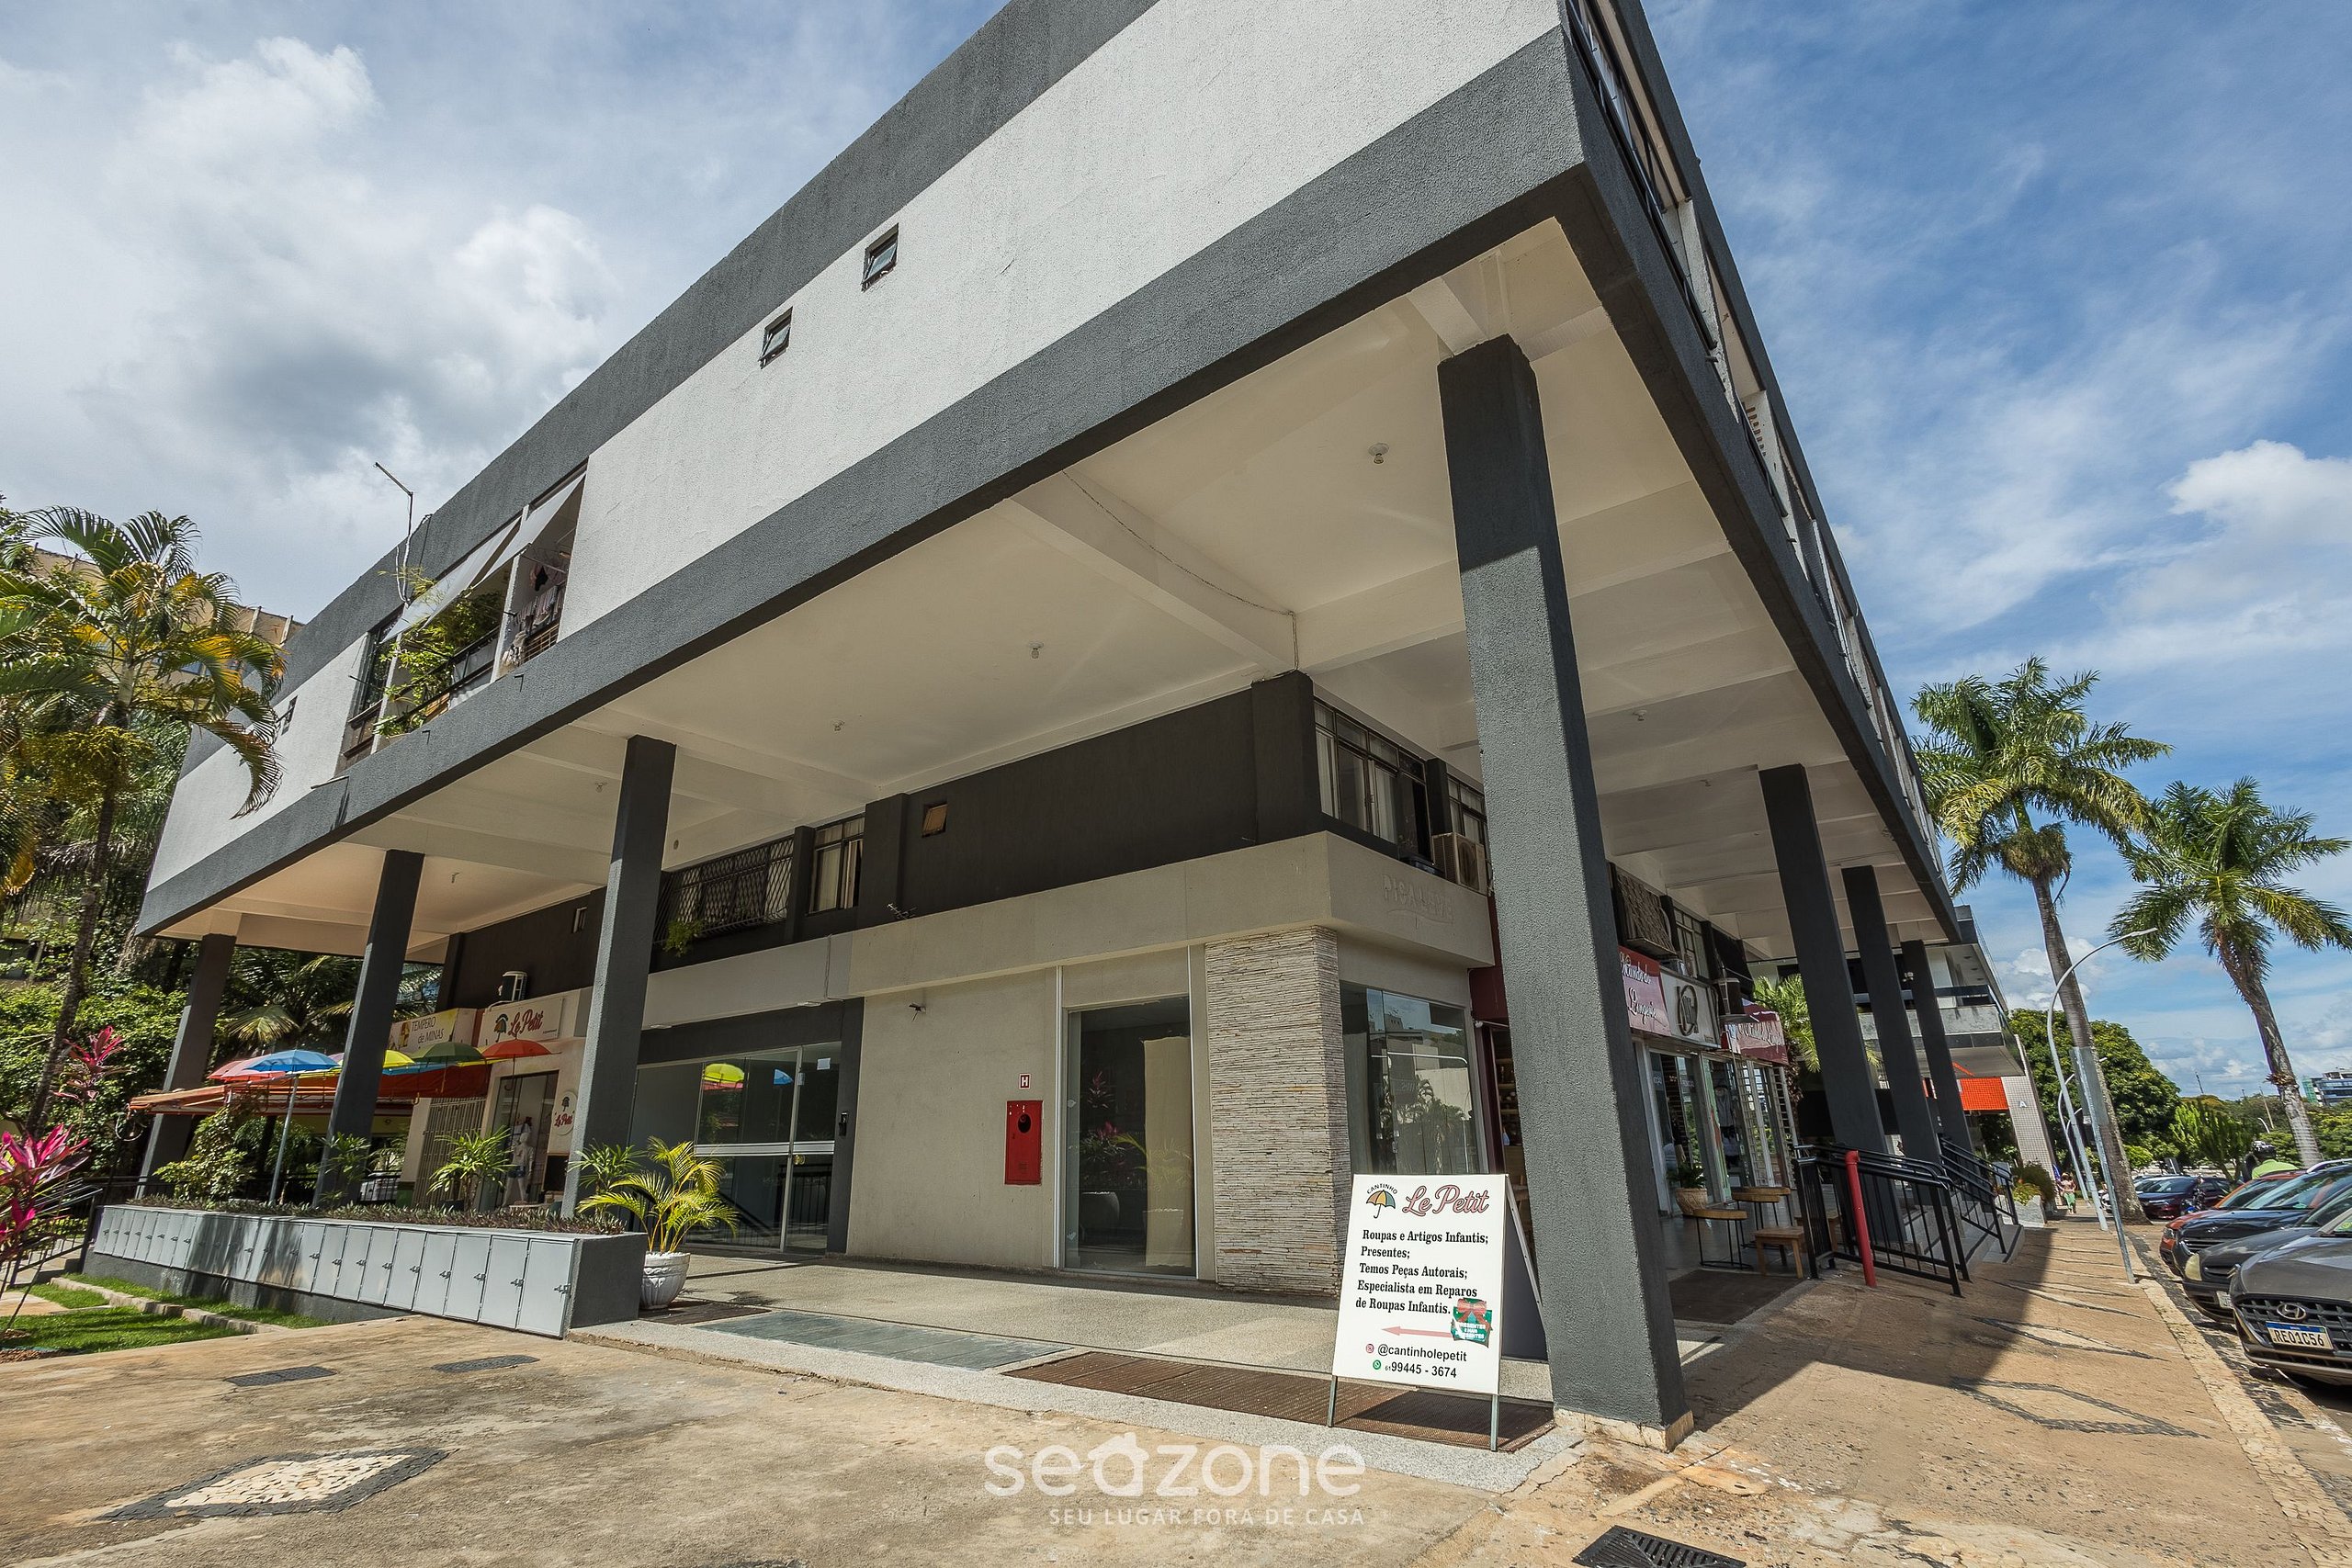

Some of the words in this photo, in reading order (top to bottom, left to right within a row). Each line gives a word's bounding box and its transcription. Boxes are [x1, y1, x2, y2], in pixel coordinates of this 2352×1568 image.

[412, 1016, 436, 1032] TEMPERO
[507, 1011, 521, 1037] Le
[519, 1009, 544, 1034] Petit
[417, 1033, 425, 1043] de
[424, 1028, 445, 1042] MINAS
[1021, 1077, 1029, 1087] H
[1366, 1183, 1398, 1195] CANTINHO
[1401, 1185, 1433, 1217] Le
[1431, 1184, 1490, 1214] Petit
[1363, 1229, 1397, 1243] Roupas
[1399, 1233, 1406, 1241] e
[1407, 1231, 1443, 1245] Artigos
[1445, 1231, 1489, 1245] Infantis;
[1361, 1246, 1410, 1259] Presentes;
[1359, 1262, 1389, 1275] Temos
[1391, 1264, 1419, 1279] Peças
[1421, 1266, 1468, 1280] Autorais;
[1357, 1280, 1416, 1294] Especialista
[1418, 1285, 1433, 1295] em
[1435, 1284, 1477, 1298] Reparos
[1355, 1297, 1367, 1309] de
[1369, 1297, 1406, 1313] Roupas
[1408, 1301, 1451, 1314] Infantis.
[1378, 1344, 1467, 1362] @cantinholepetit
[1431, 1365, 1457, 1378] 3674
